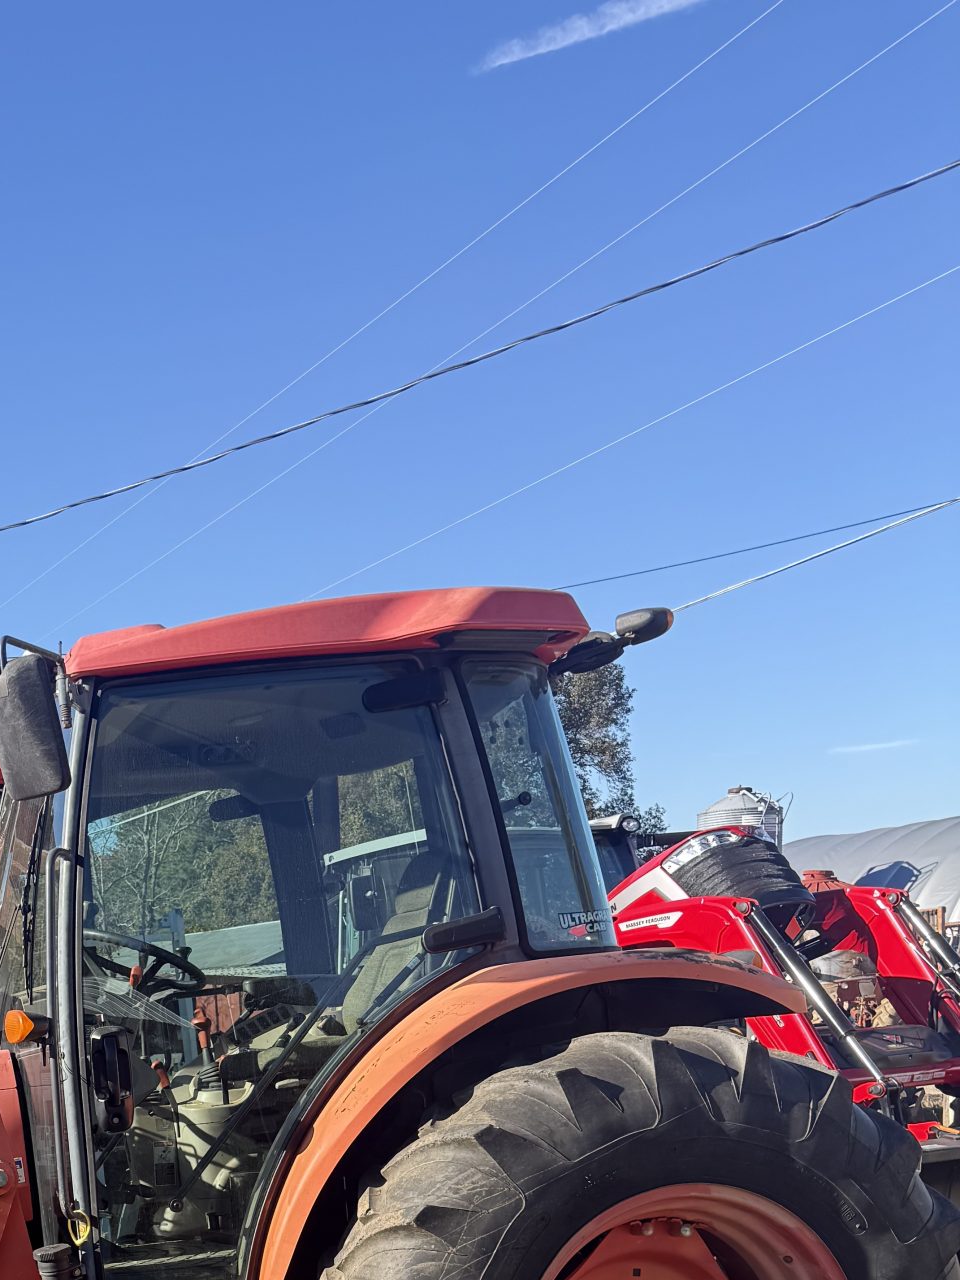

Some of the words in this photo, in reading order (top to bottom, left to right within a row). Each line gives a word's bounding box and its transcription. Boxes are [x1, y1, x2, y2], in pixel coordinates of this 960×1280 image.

[585, 921, 607, 933] CAB
[625, 920, 645, 929] MASSEY
[645, 915, 671, 925] FERGUSON
